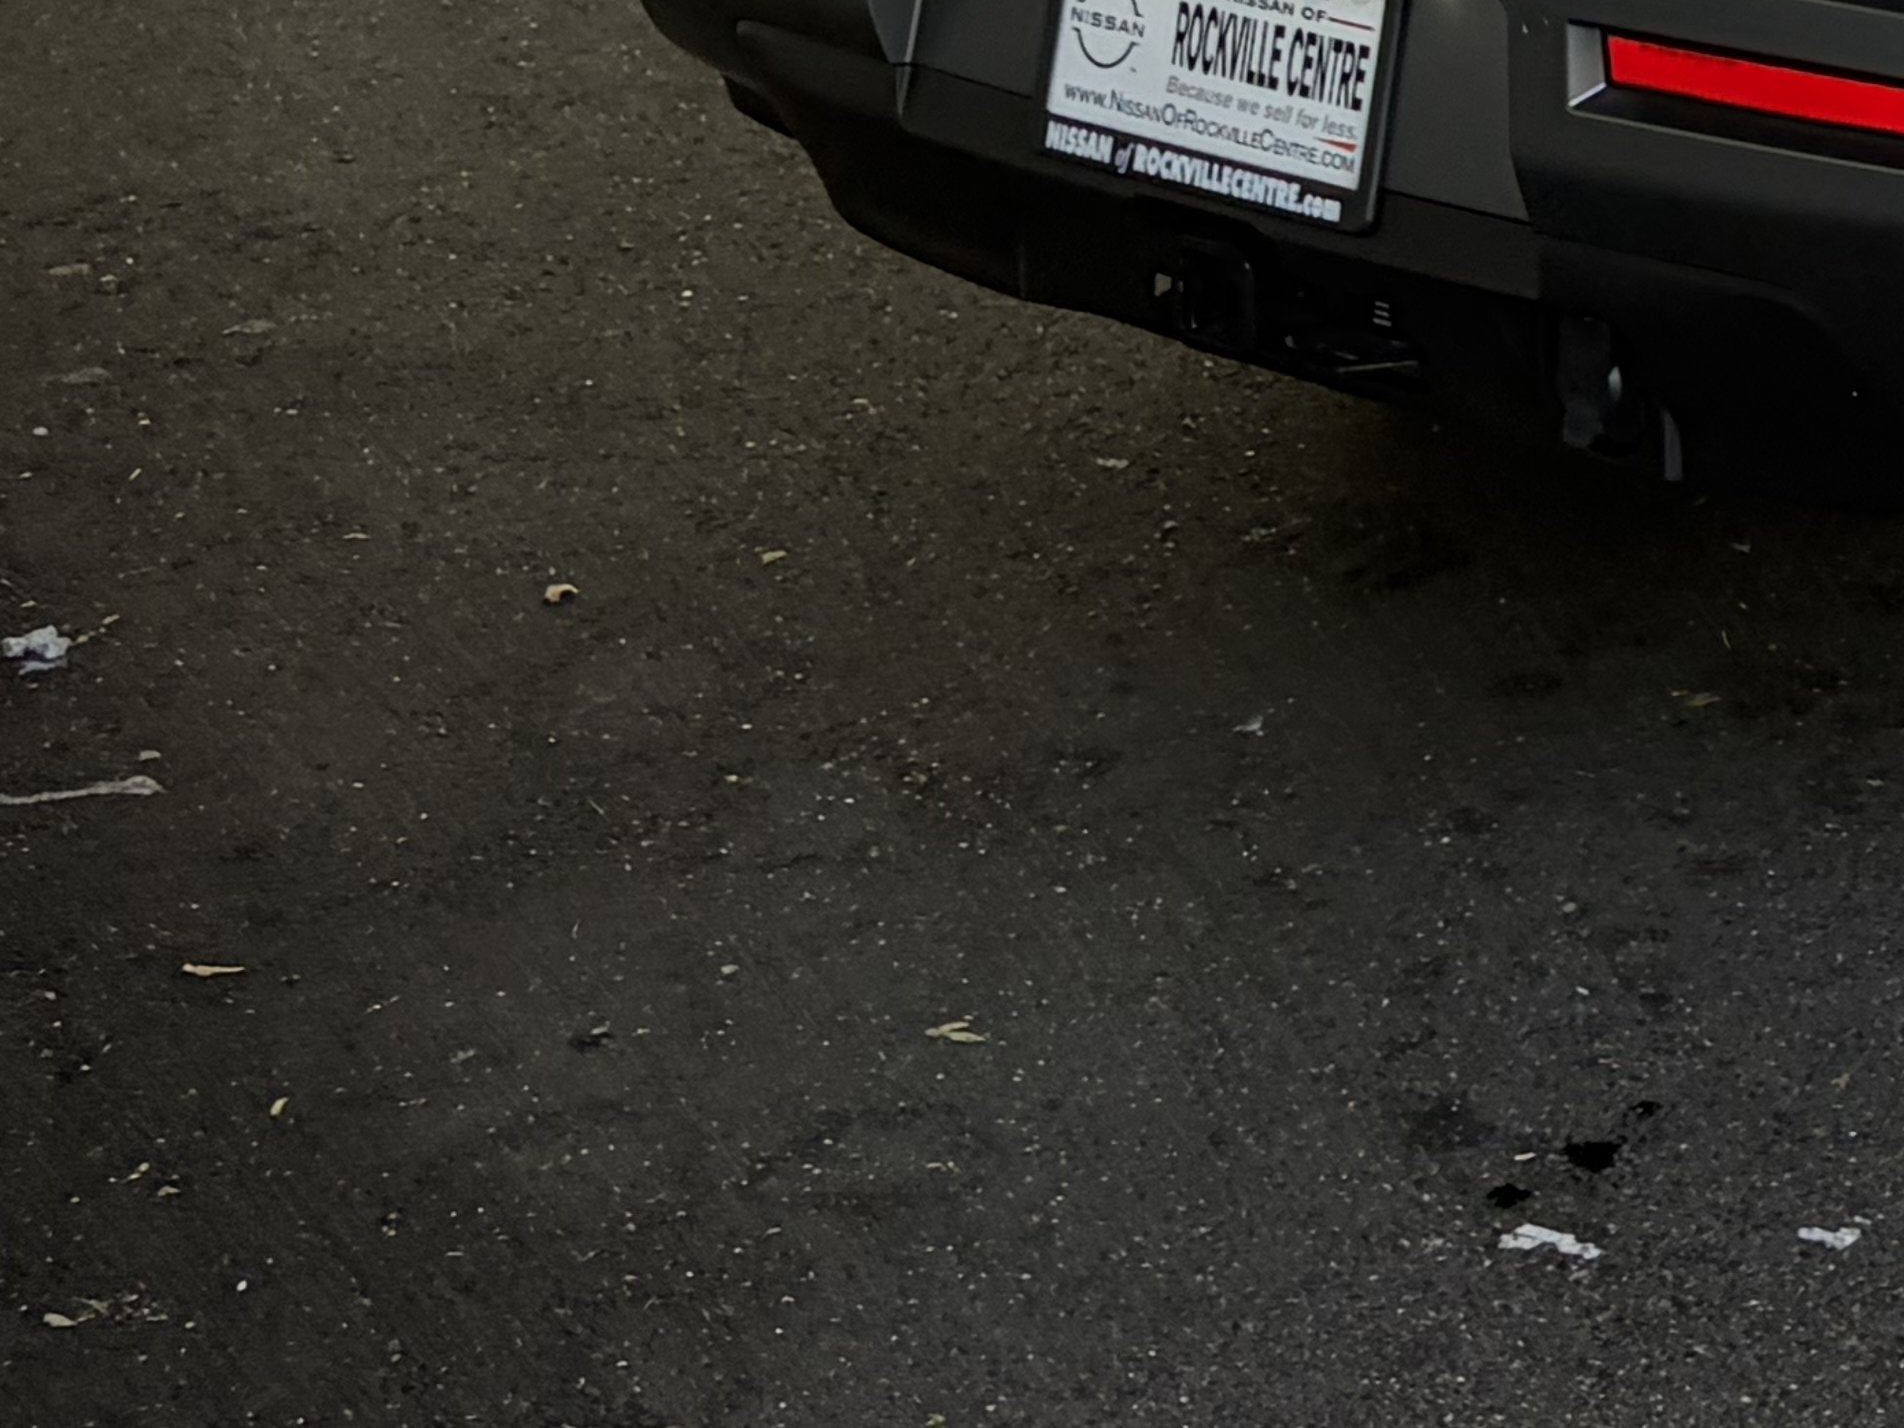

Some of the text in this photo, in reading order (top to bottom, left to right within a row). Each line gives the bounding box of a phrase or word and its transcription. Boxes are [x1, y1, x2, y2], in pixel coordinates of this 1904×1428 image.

[1070, 5, 1146, 39] NISSAN
[1300, 6, 1330, 23] OF
[1171, 0, 1371, 112] ROCKVILLE CENTRE
[1236, 93, 1260, 116] we
[1297, 106, 1320, 131] for
[1045, 120, 1114, 164] NISSAN
[1115, 141, 1135, 175] of
